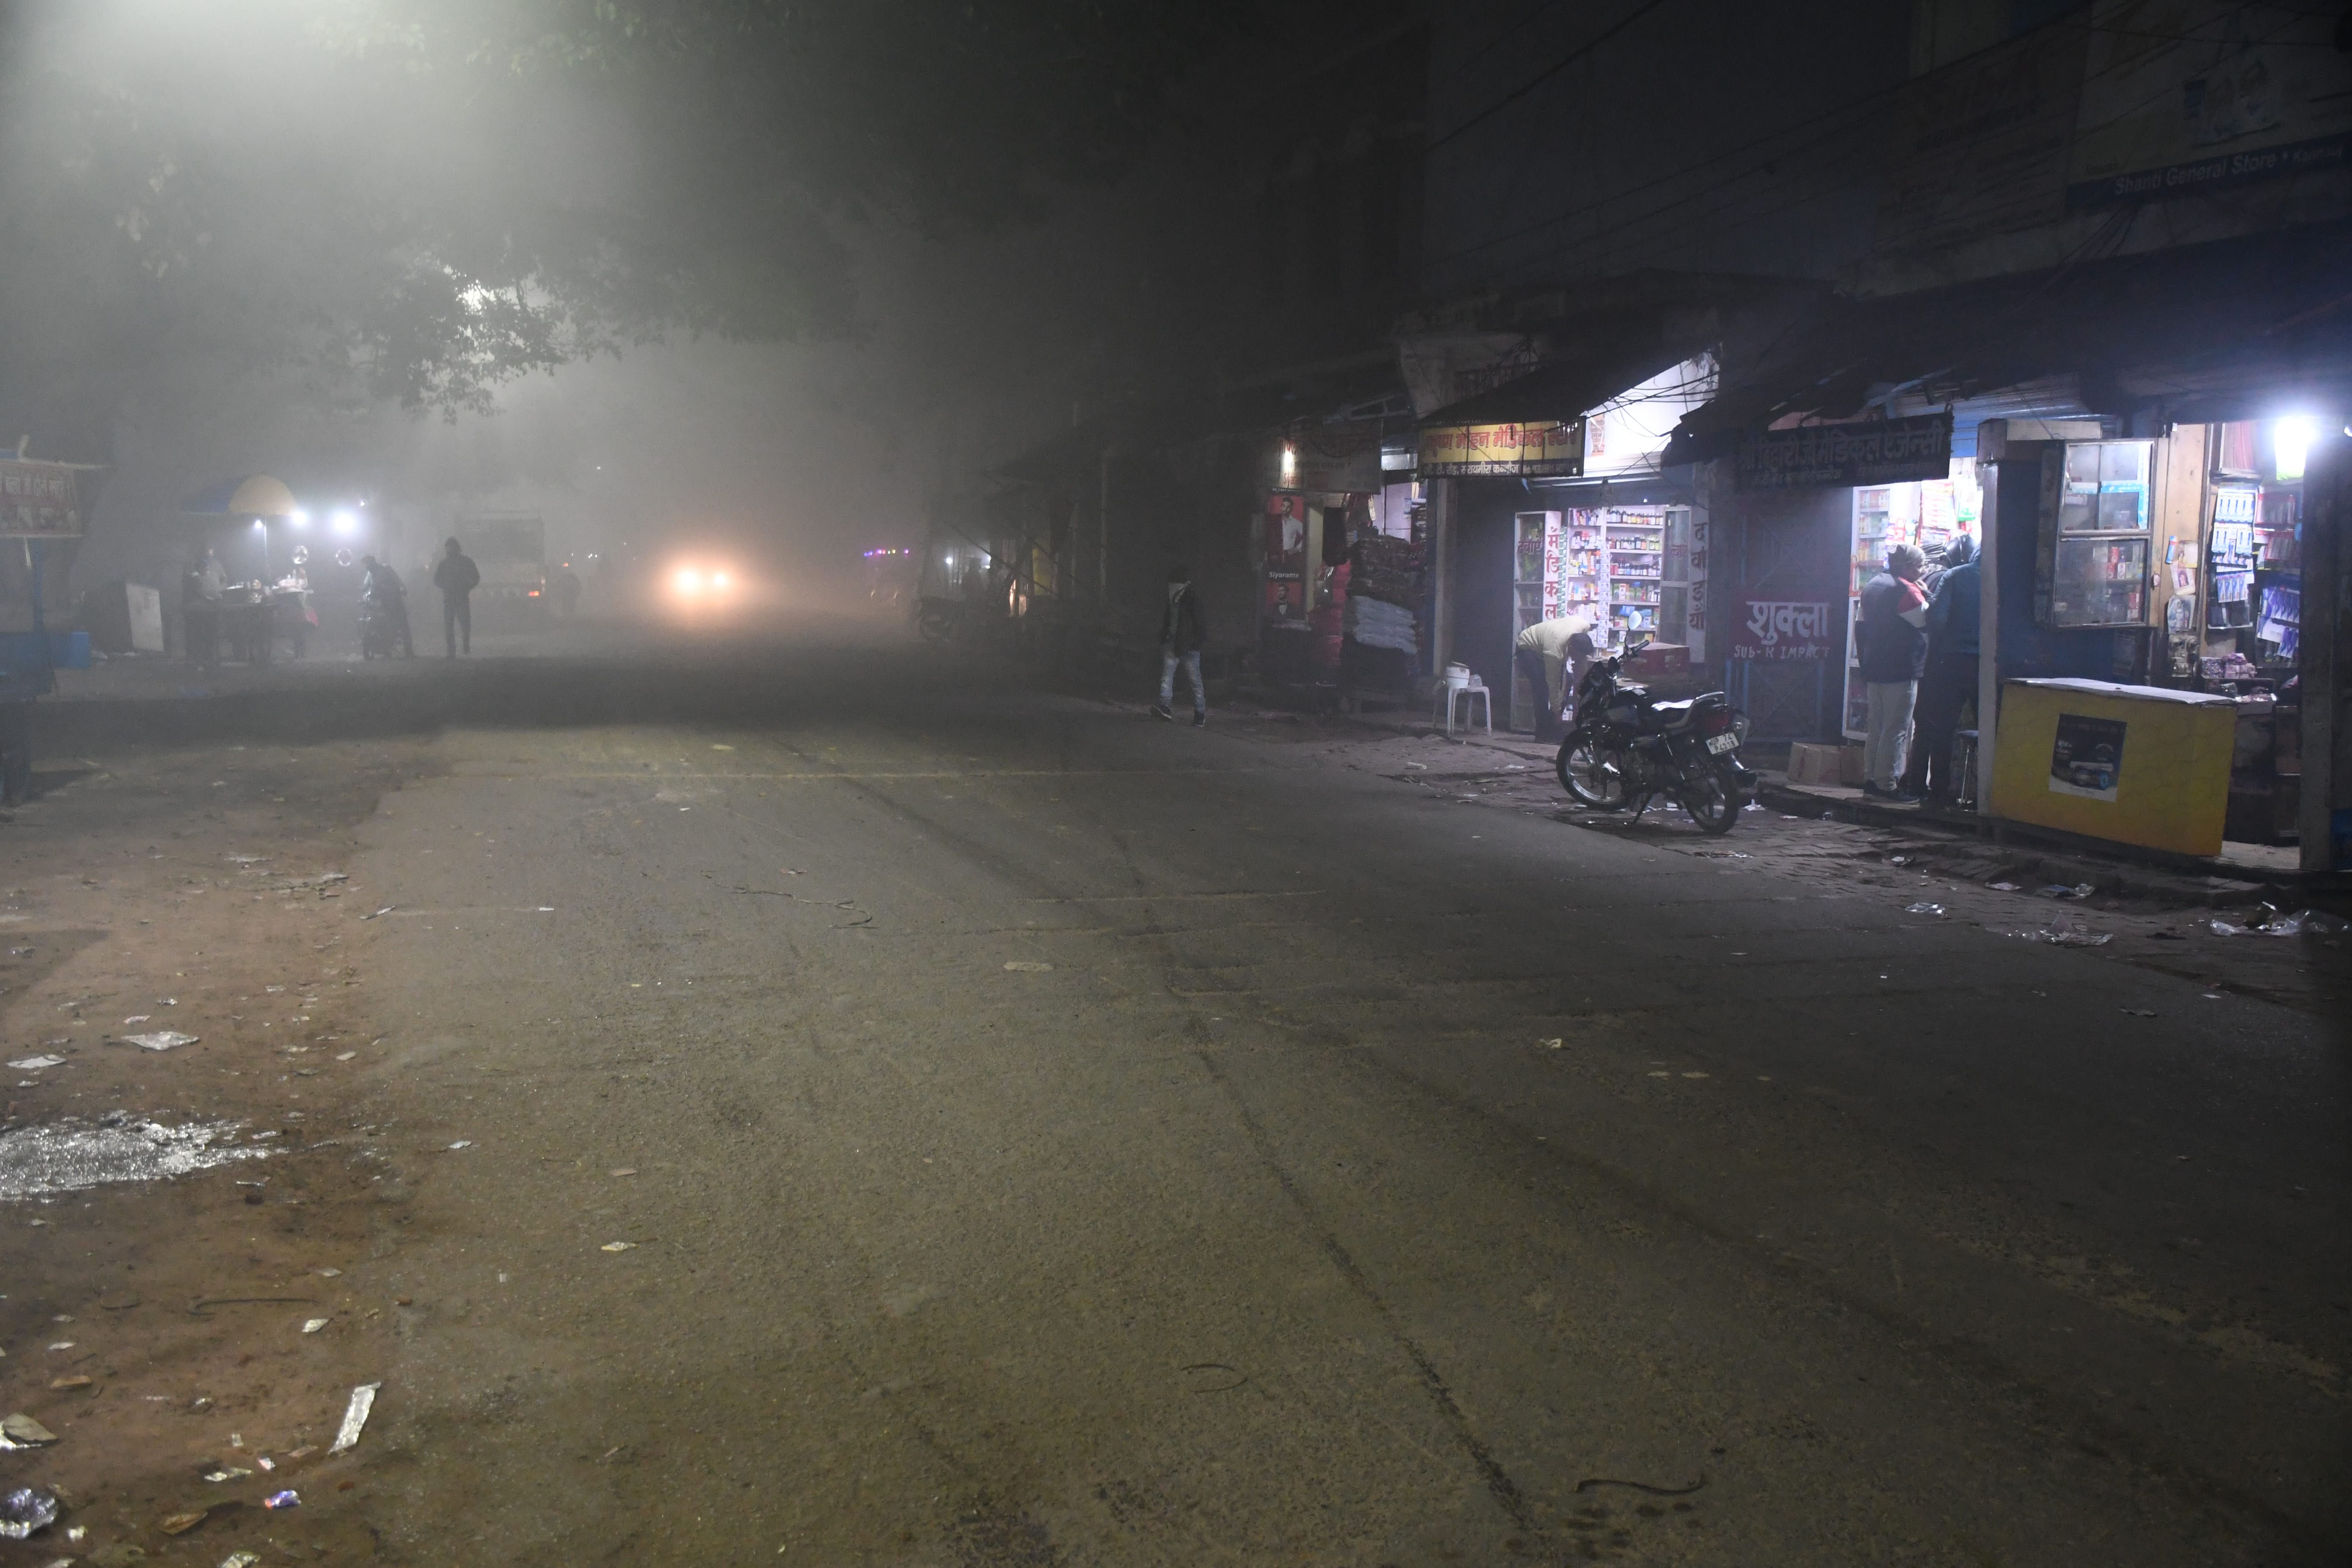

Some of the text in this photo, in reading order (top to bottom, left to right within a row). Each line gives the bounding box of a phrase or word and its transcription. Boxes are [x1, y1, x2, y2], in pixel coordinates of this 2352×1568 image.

[2115, 170, 2162, 195] Shanti
[2166, 159, 2227, 187] General
[2231, 152, 2278, 175] Store
[1746, 602, 1831, 645] शुक्ला
[1780, 646, 1831, 659] IMPACT
[1722, 734, 1732, 742] 74
